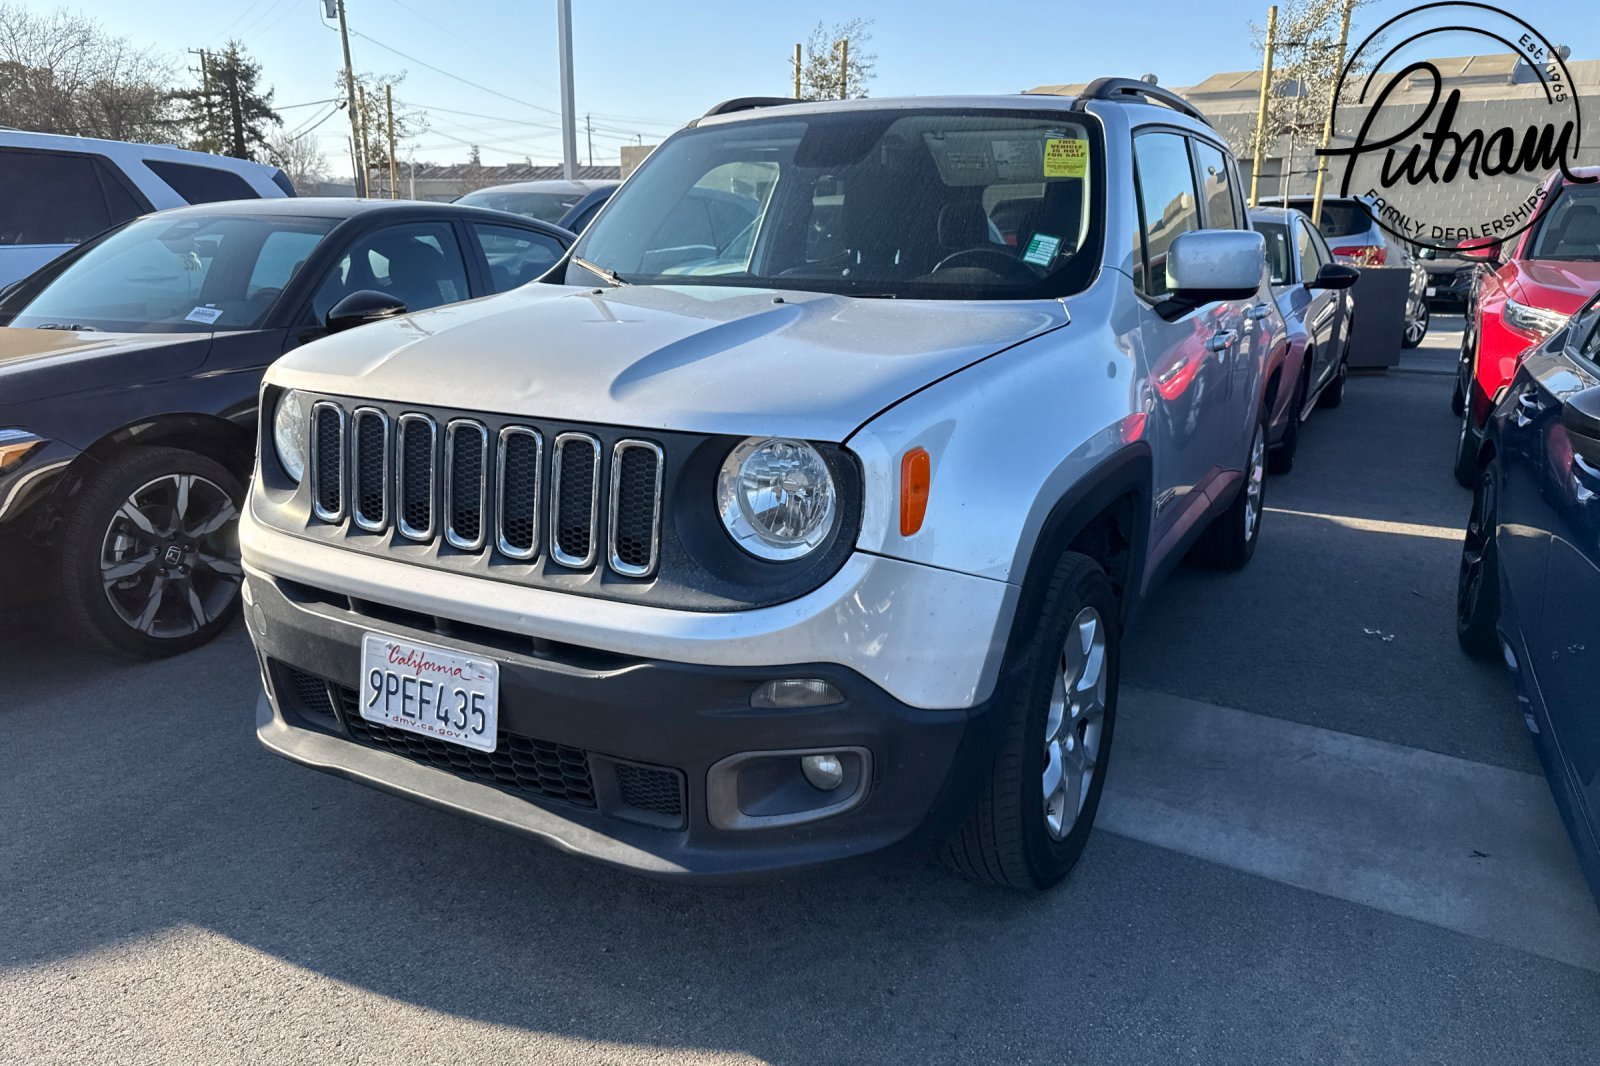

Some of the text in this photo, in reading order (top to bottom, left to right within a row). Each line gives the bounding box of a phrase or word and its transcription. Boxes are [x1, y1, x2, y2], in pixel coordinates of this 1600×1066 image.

[388, 644, 472, 681] California
[368, 669, 486, 735] 9PEF435
[392, 715, 462, 737] dmv.ca.gov
